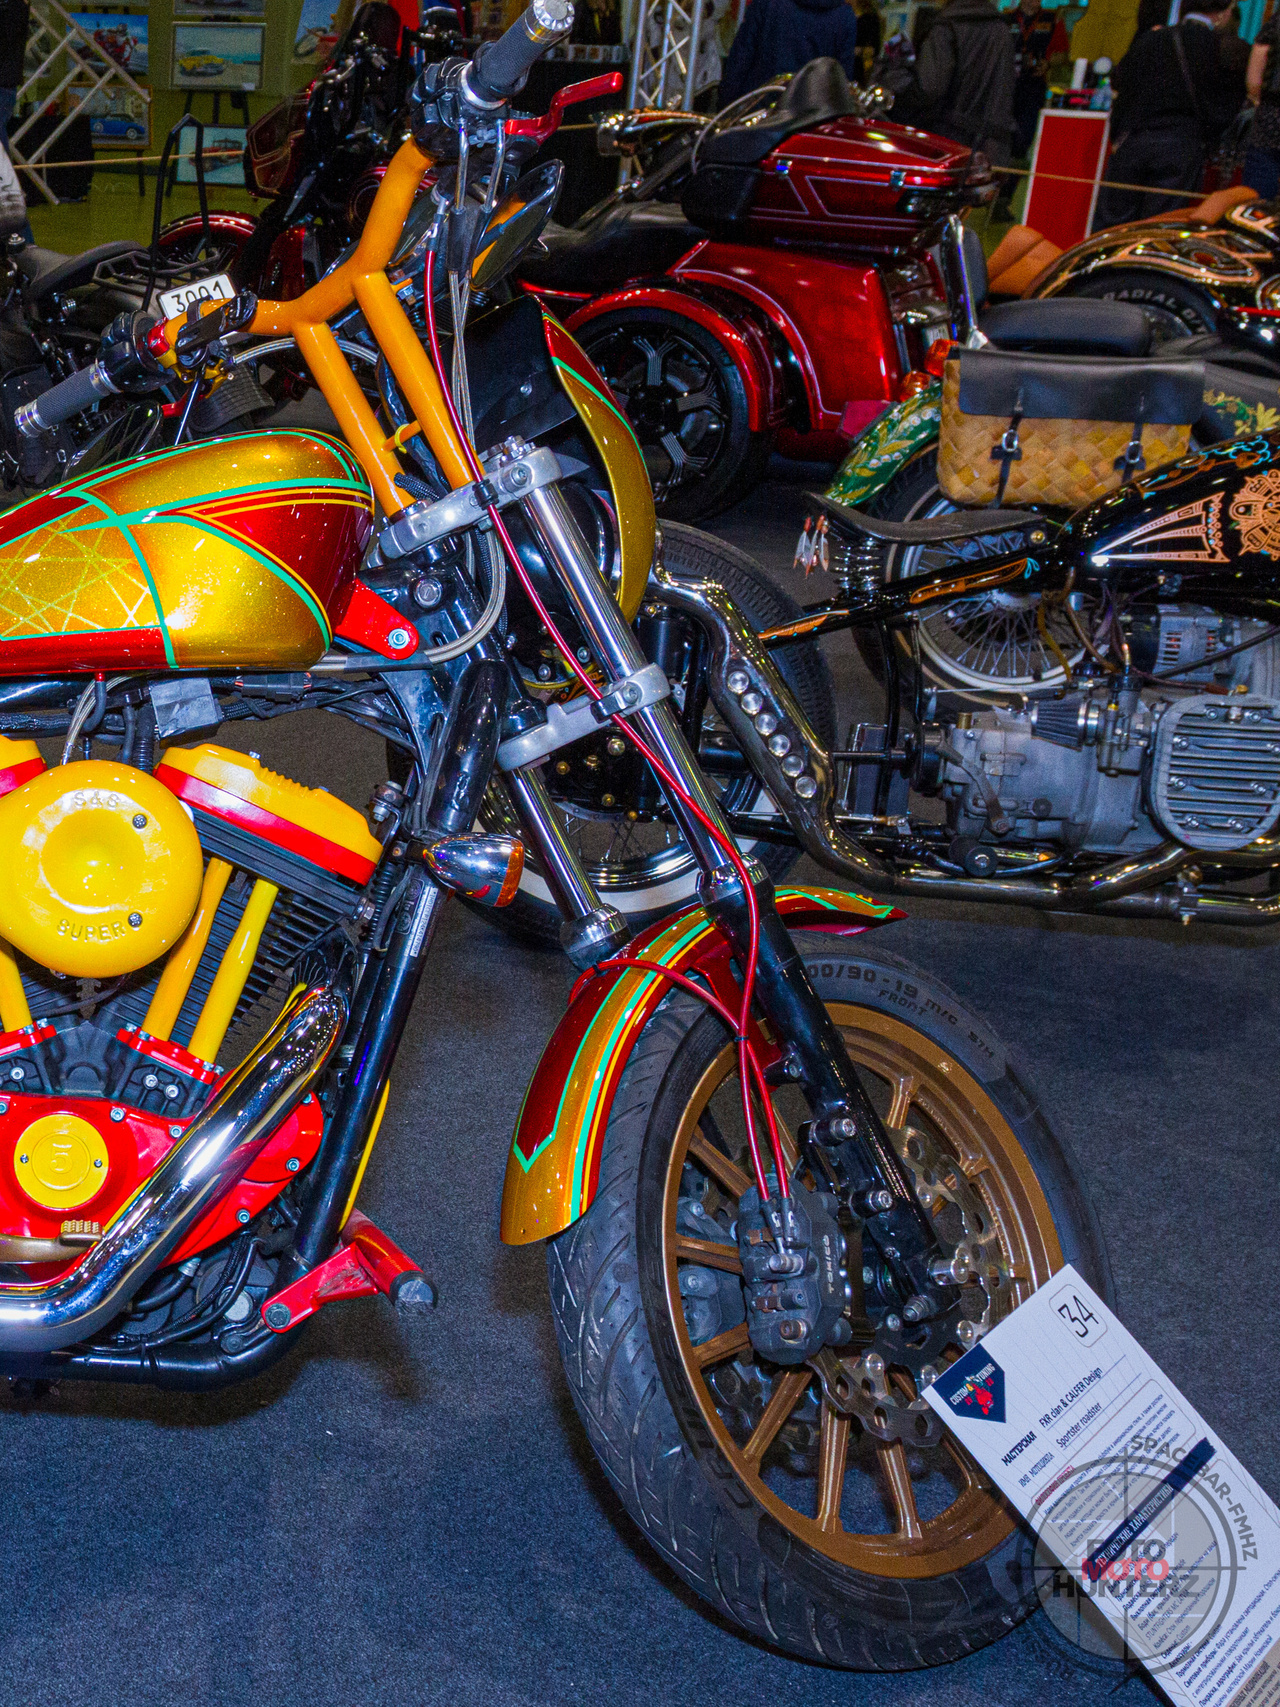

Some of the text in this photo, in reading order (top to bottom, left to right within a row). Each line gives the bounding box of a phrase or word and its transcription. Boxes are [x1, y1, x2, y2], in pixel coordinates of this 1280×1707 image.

[56, 918, 127, 943] SUPER
[1056, 1292, 1101, 1340] 34
[1037, 1412, 1053, 1428] FXR
[1047, 1401, 1064, 1419] clan
[1063, 1379, 1087, 1403] CALFER
[1081, 1363, 1104, 1388] Design
[1054, 1400, 1104, 1450] Sportster roadster
